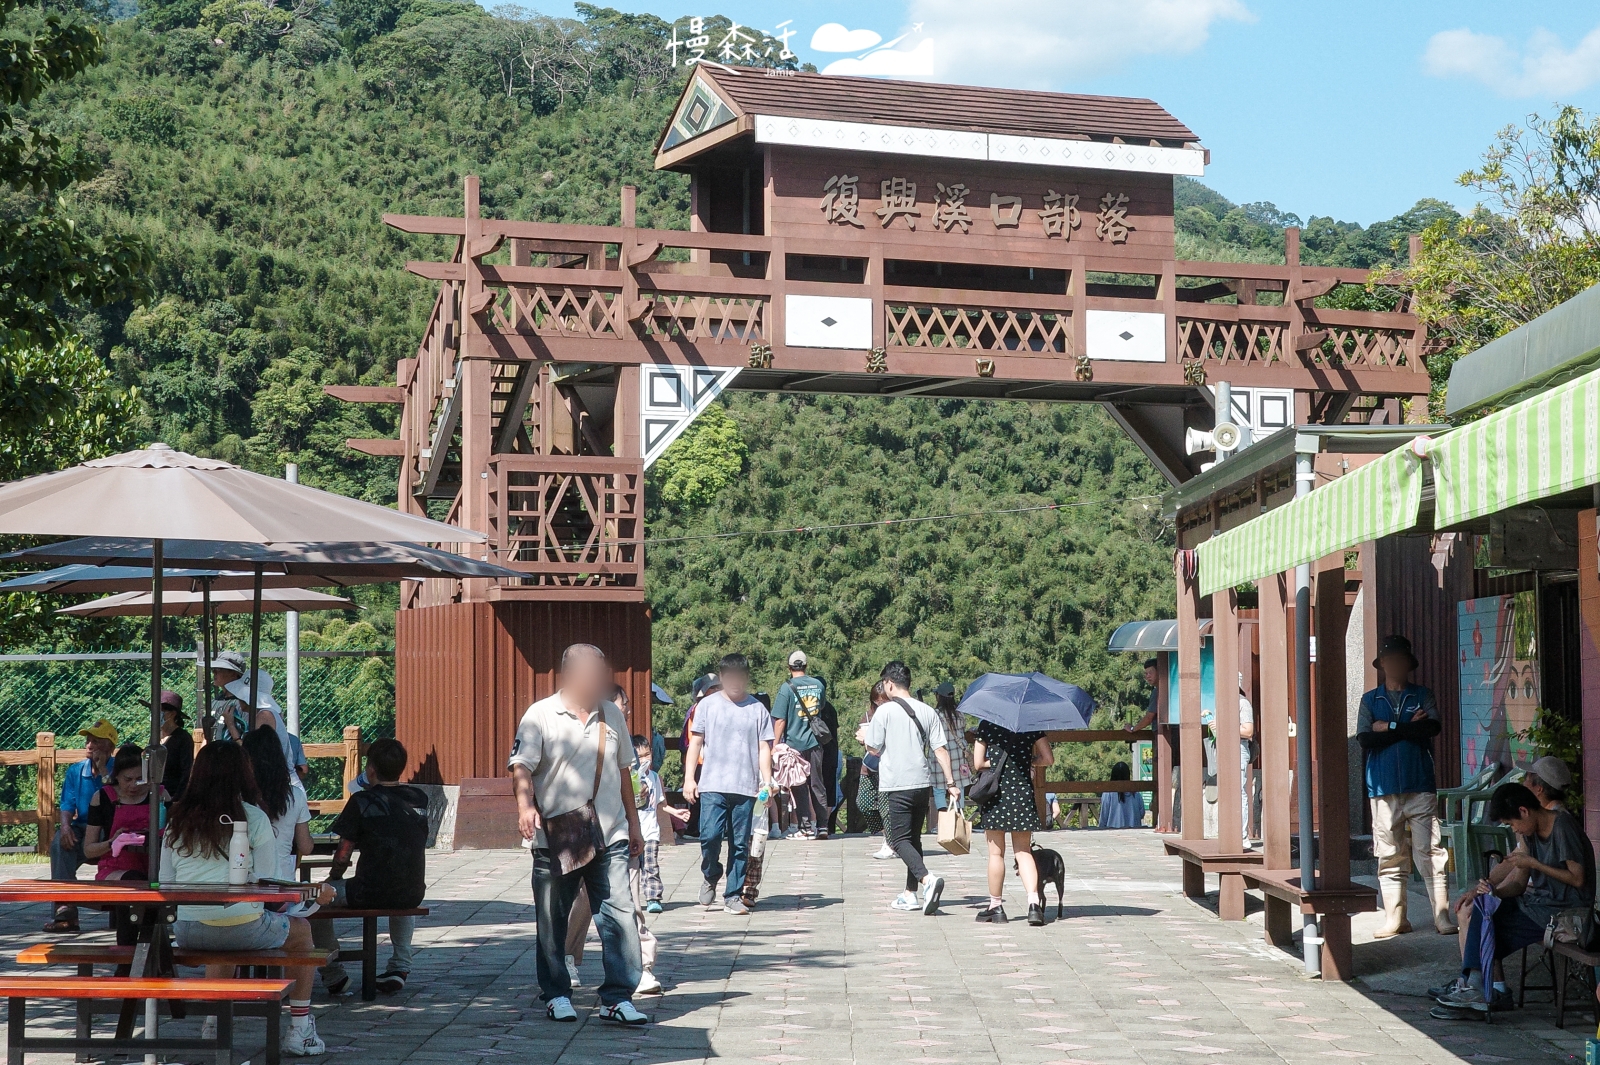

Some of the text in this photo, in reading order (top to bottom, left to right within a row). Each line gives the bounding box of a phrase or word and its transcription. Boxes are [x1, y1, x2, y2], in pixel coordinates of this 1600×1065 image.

[820, 174, 1136, 245] 復興溪口部落
[748, 342, 1206, 386] 新溪口吊橋
